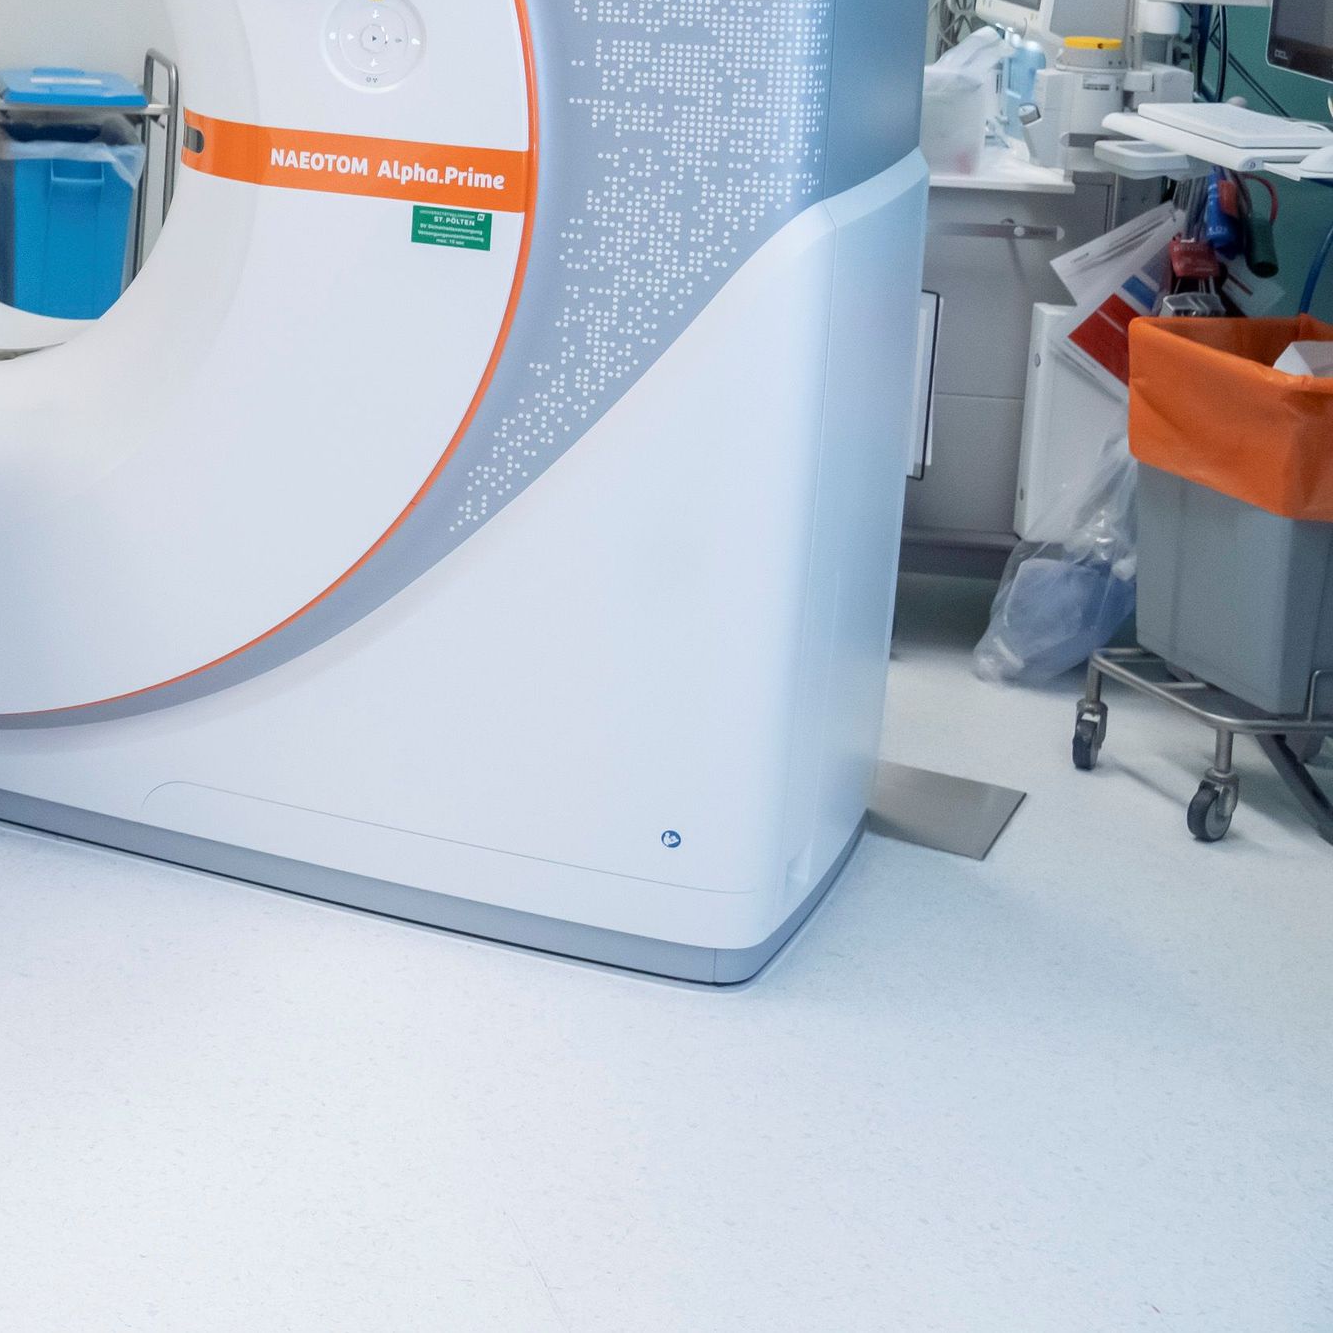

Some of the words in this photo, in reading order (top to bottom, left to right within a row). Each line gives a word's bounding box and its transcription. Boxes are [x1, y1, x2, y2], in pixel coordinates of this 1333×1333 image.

[269, 147, 369, 176] NAEOTOM
[377, 159, 506, 191] Alpha.Prime
[445, 216, 475, 226] PÖLTEN
